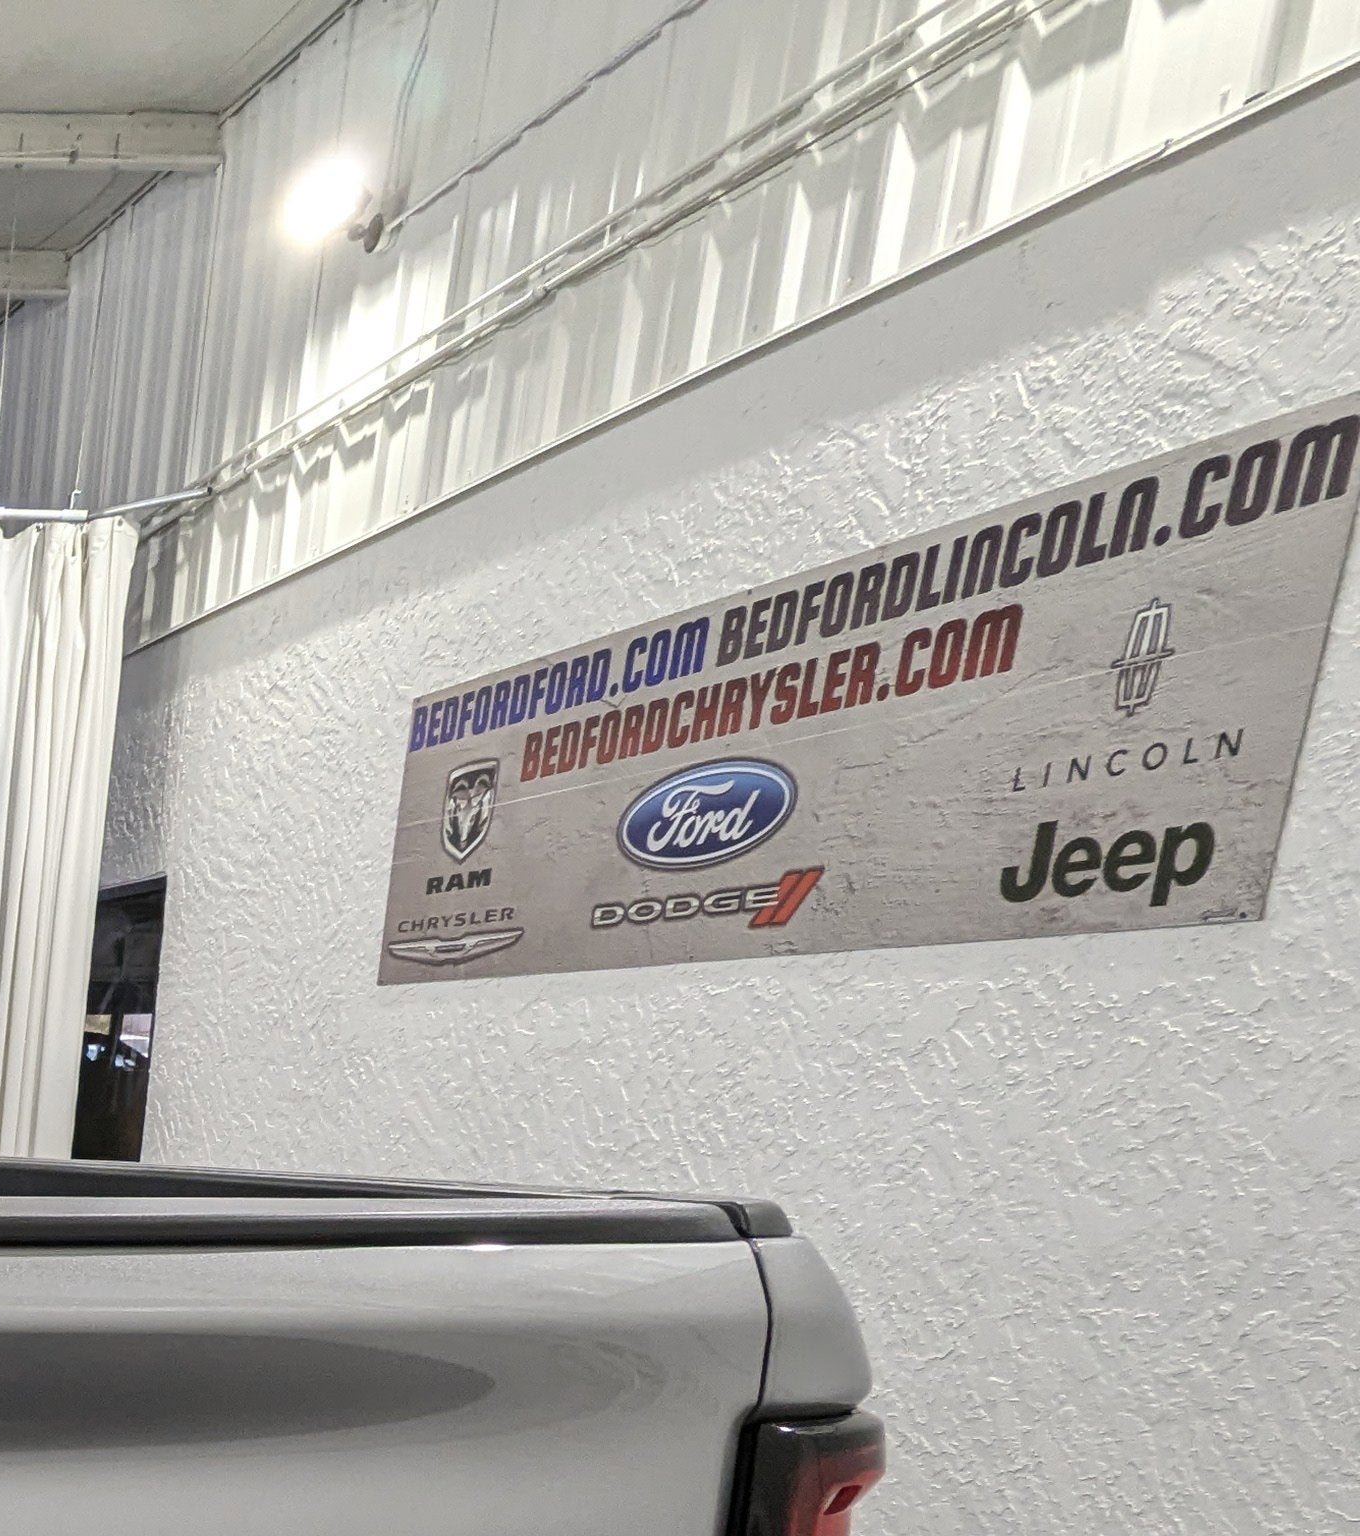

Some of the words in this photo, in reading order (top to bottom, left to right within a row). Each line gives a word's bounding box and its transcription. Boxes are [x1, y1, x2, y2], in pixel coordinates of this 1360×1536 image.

[409, 617, 710, 752] BEDFORDFORD.COM
[716, 414, 1360, 667] BEDFORDLINCOLN.COM
[520, 602, 1023, 782] BEDFORDCHRYSLER.COM
[1012, 728, 1244, 792] LINCOLN
[646, 779, 761, 852] Ford
[425, 868, 492, 895] RAM
[999, 820, 1215, 907] Jeep
[397, 907, 515, 933] CHRYSLER
[591, 885, 781, 930] DODGE
